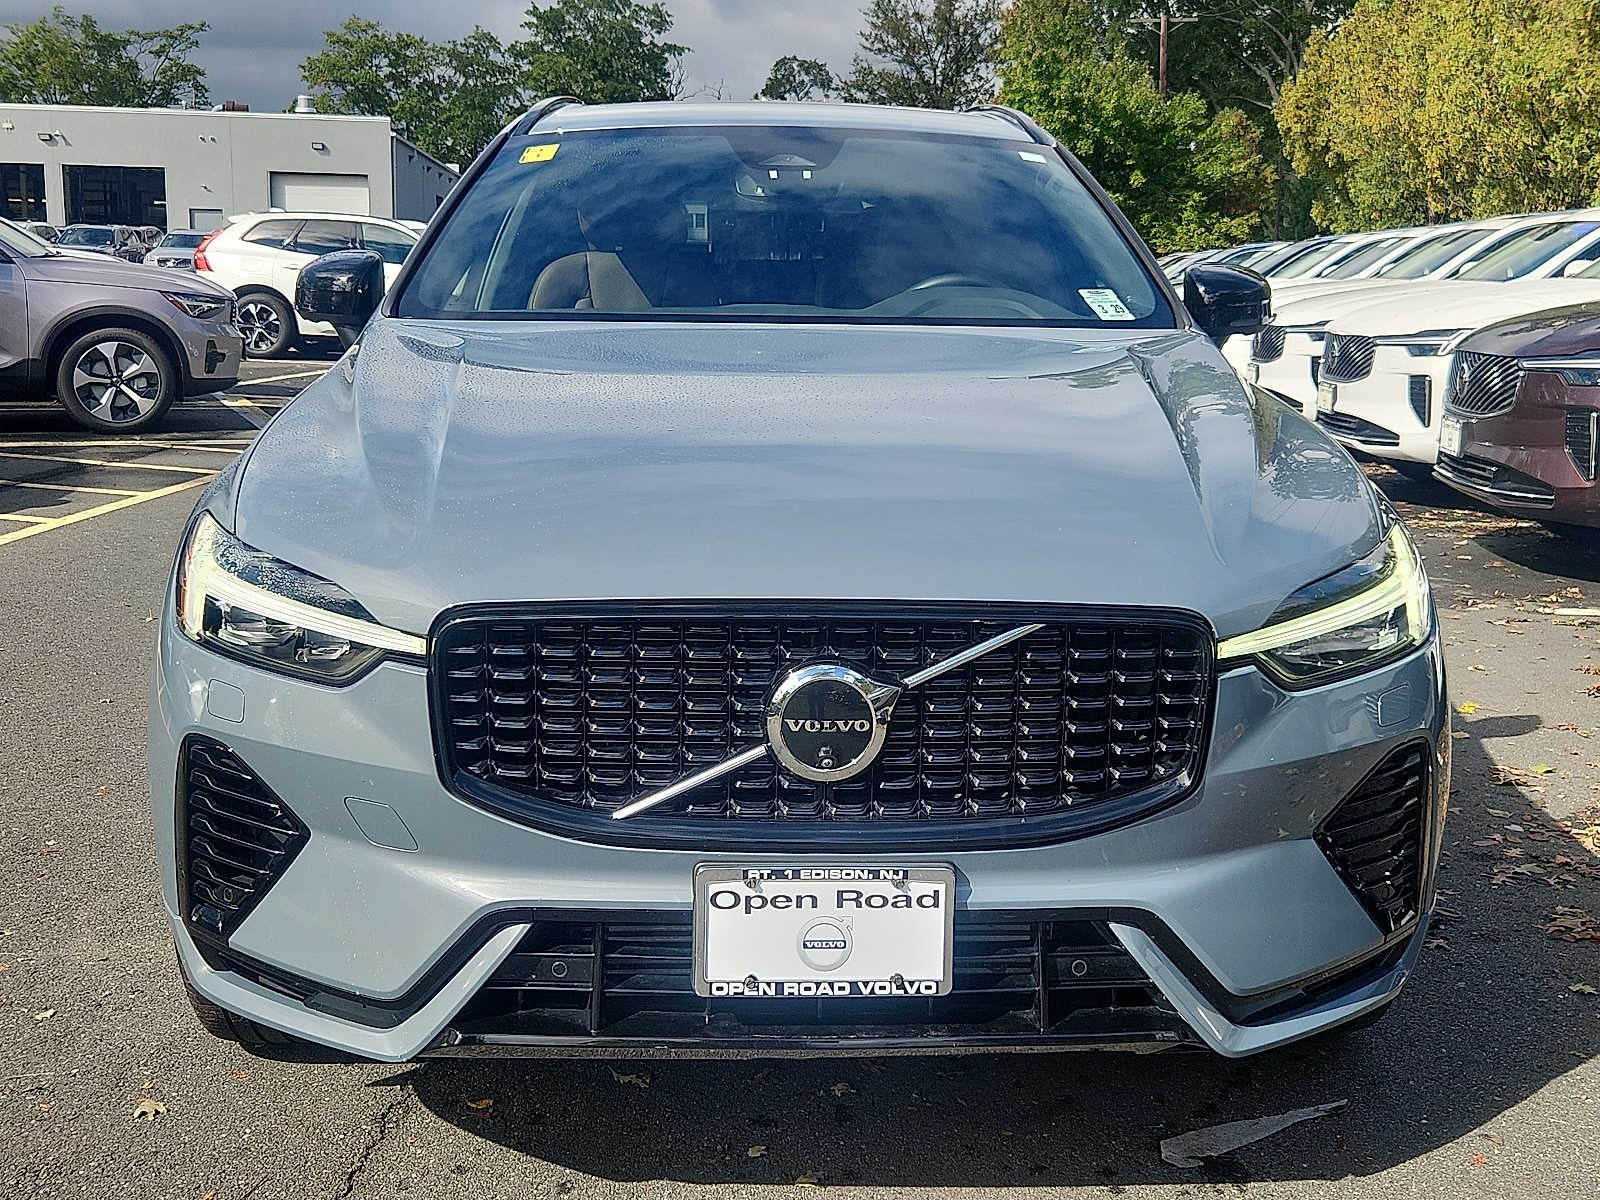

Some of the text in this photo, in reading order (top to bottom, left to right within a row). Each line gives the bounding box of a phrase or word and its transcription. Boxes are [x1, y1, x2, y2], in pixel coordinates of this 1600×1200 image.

[783, 719, 870, 733] VOLVO
[747, 869, 904, 880] RT. 1 EDISON, NJ
[709, 890, 940, 914] Open Road
[804, 941, 846, 949] VOLVO
[711, 981, 938, 996] OPEN ROAD VOLVO
